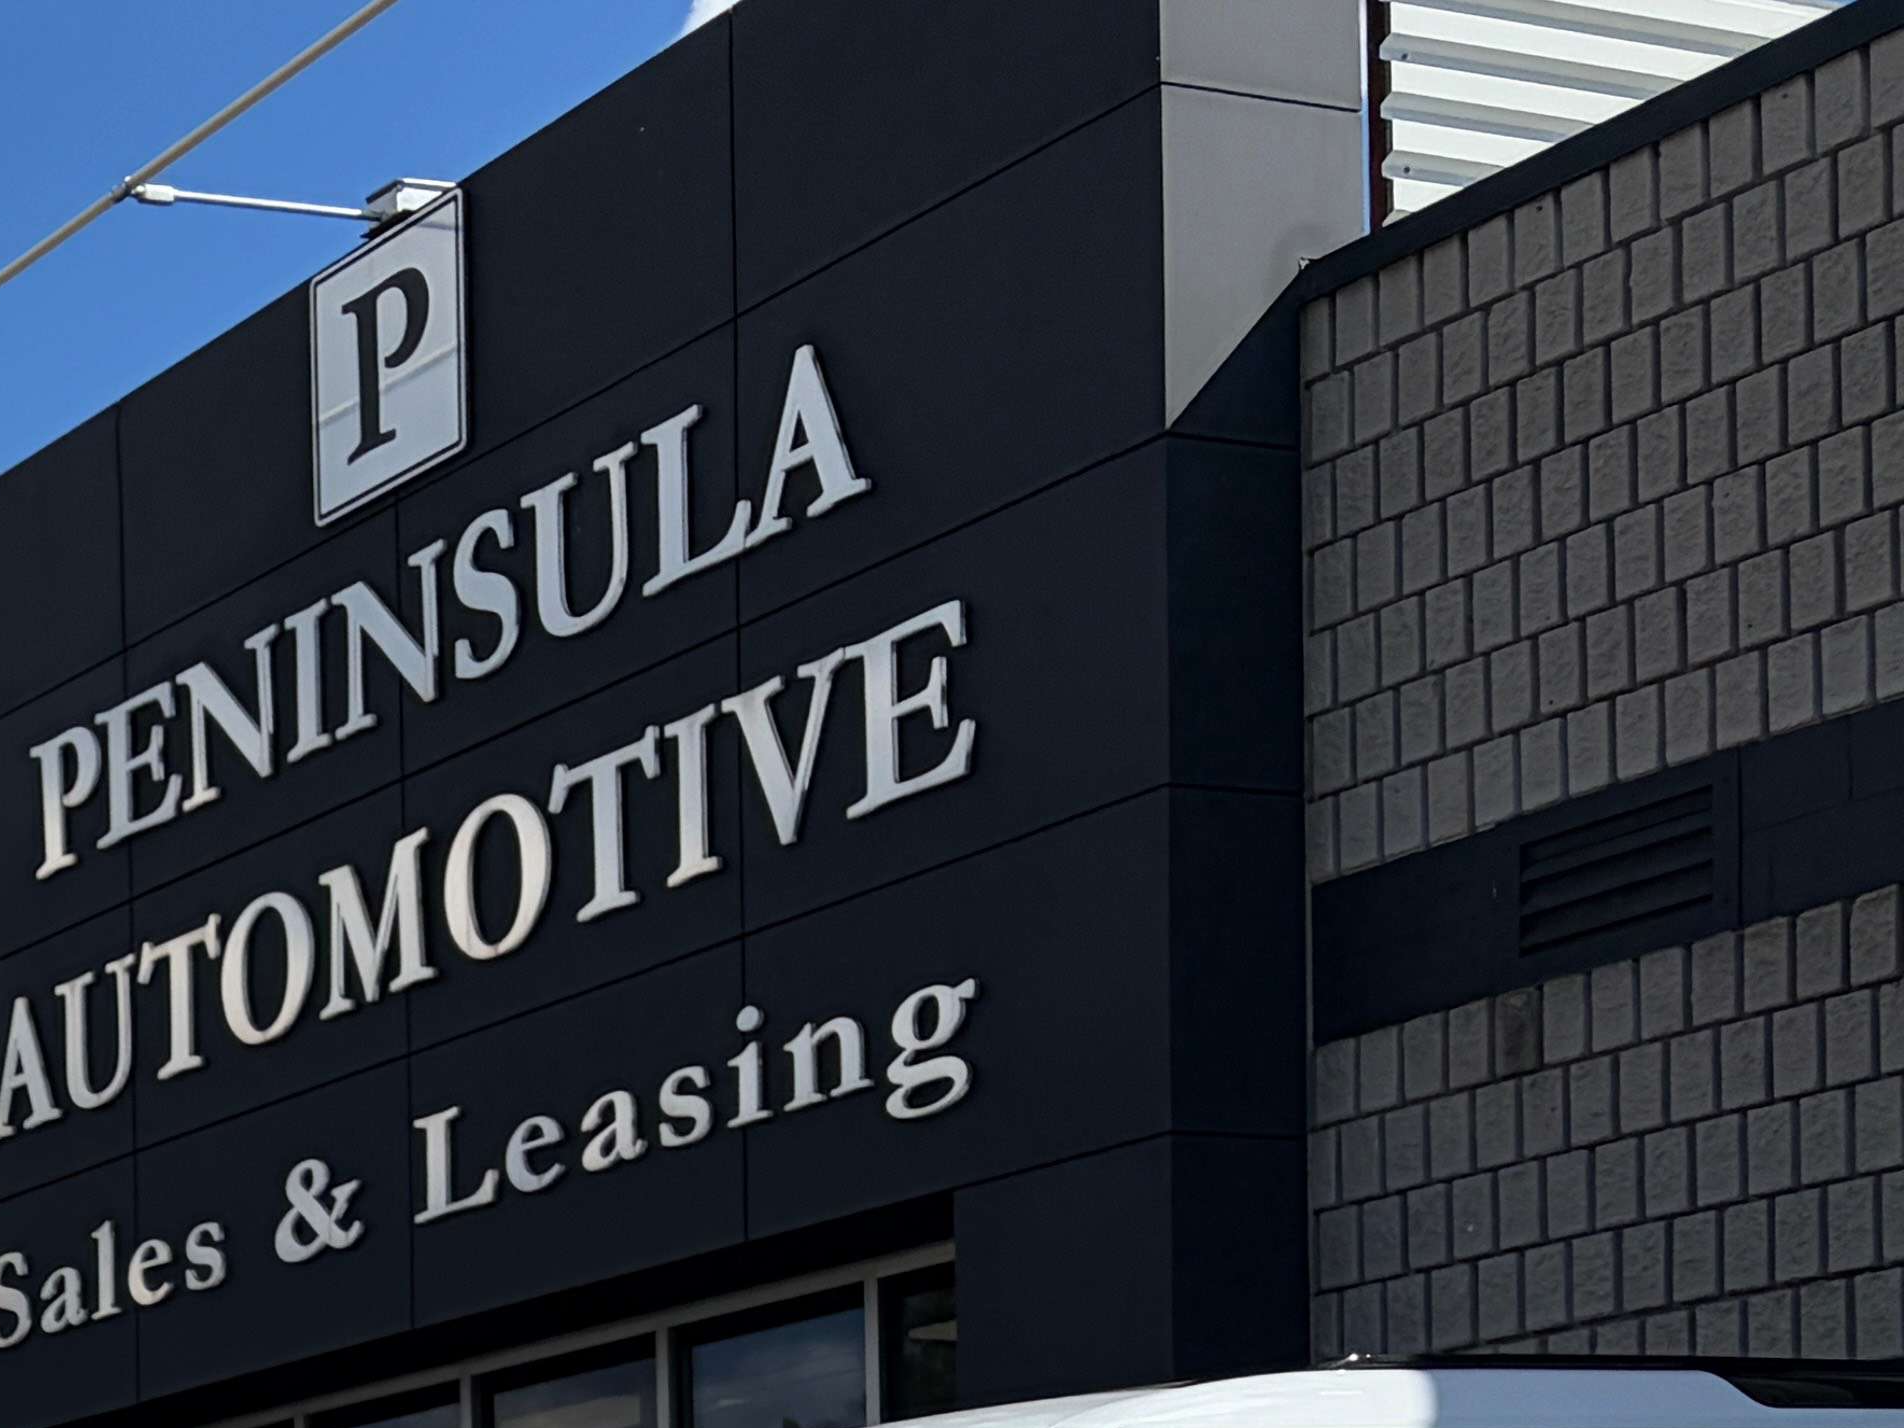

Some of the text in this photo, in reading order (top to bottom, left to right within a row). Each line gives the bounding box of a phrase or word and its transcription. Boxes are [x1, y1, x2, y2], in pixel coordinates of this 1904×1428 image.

[341, 264, 431, 466] P
[29, 343, 873, 880] PENINSULA
[273, 1157, 366, 1264] &
[412, 976, 977, 1225] Leasing
